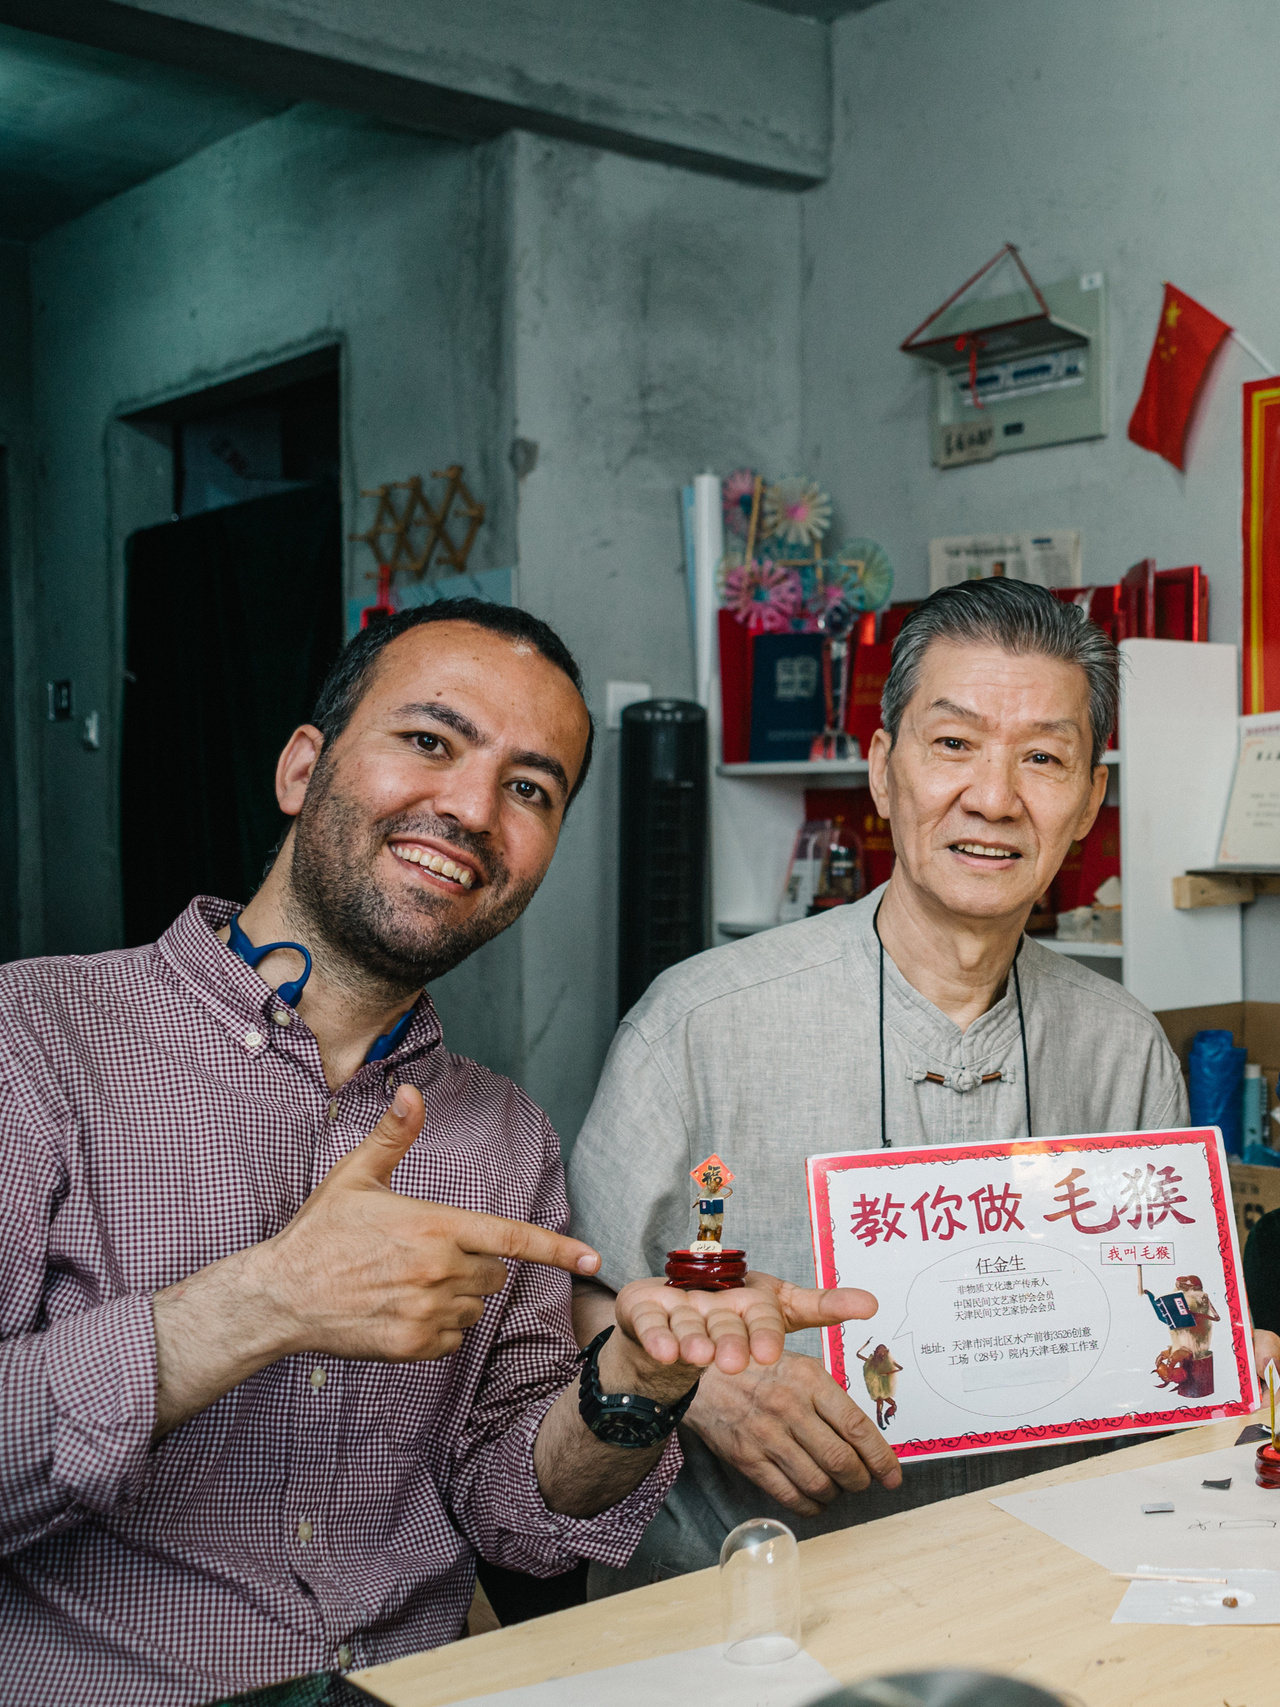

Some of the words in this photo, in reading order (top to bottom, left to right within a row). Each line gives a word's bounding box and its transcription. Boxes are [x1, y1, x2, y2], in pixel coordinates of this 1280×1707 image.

[850, 1182, 1026, 1248] 教你做
[1043, 1163, 1196, 1235] 毛猴
[1106, 1244, 1171, 1262] 我叫毛猴
[974, 1254, 1027, 1276] 任金生
[956, 1276, 1050, 1296] 非物质文化遗产传承人
[953, 1290, 1055, 1311] 中国民间文艺家协会会员
[954, 1301, 1057, 1322] 天津民间文艺家协会会员
